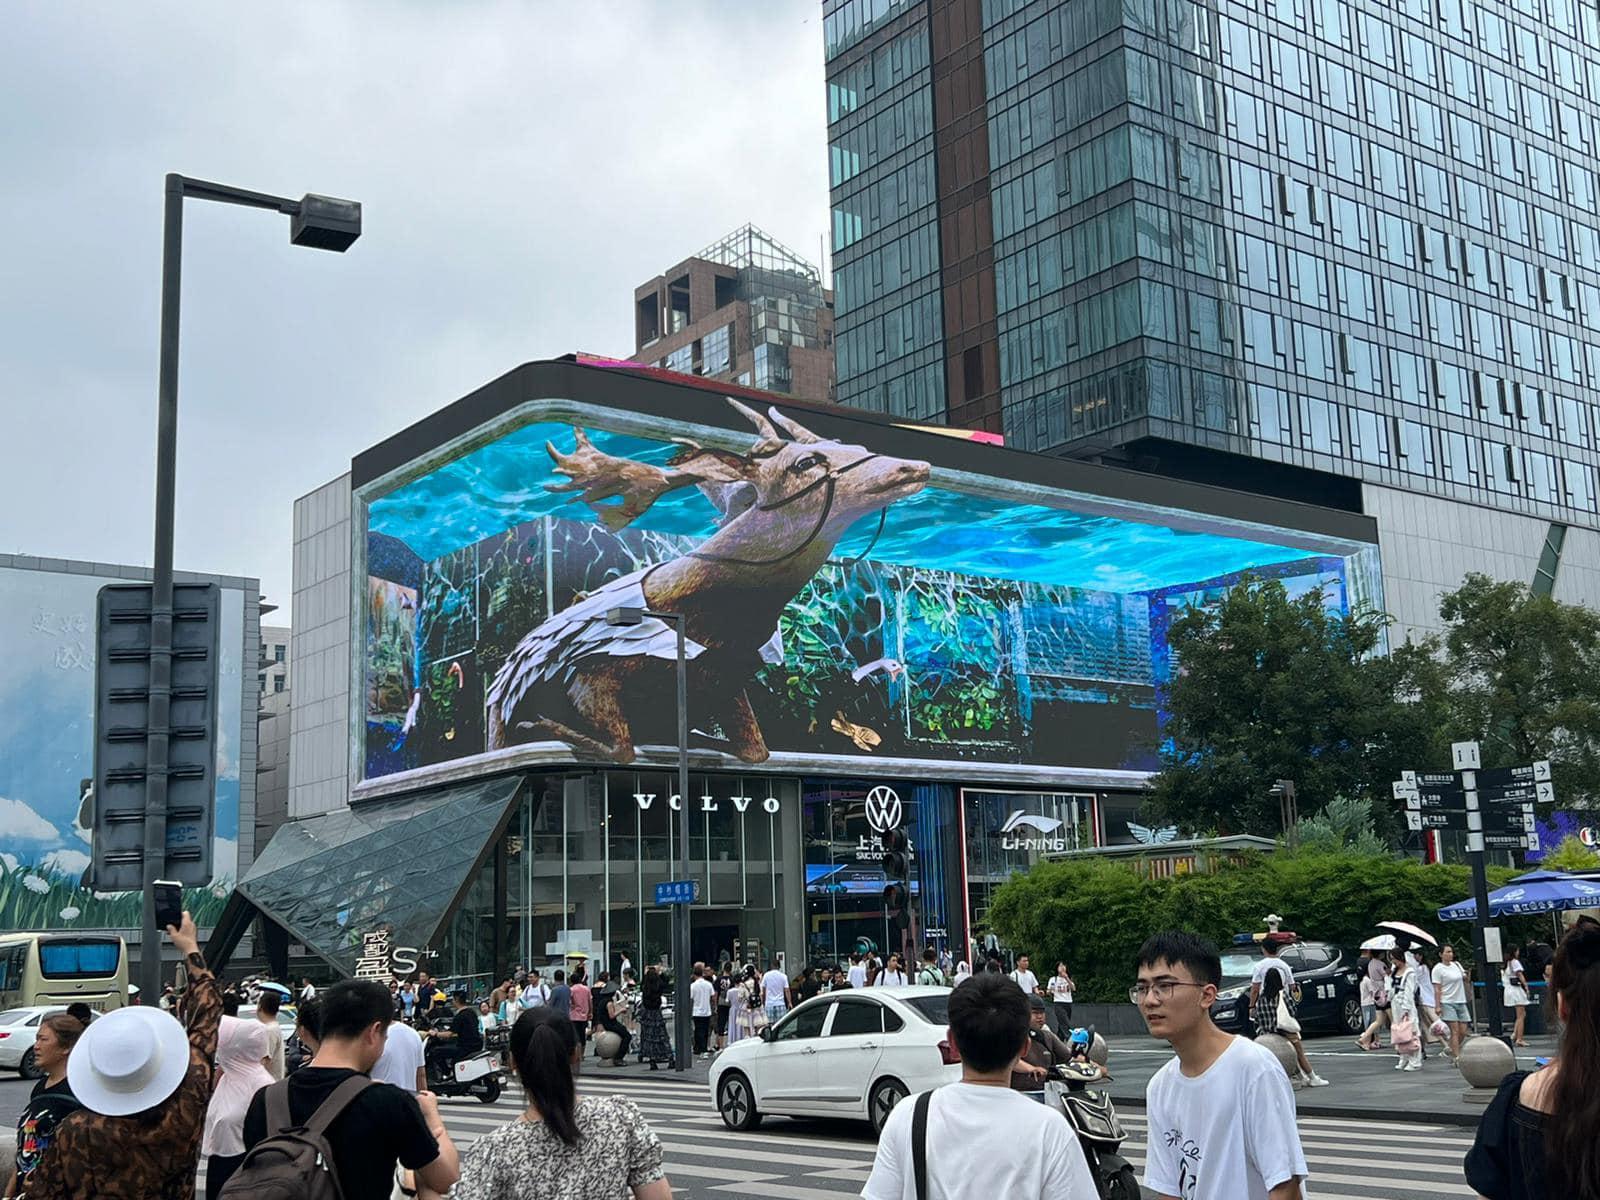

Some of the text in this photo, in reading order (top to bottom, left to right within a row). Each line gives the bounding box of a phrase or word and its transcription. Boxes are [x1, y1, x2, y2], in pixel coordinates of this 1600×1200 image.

[633, 793, 781, 813] VOLVO
[856, 834, 914, 852] 上汽
[1002, 837, 1065, 850] LI-NING
